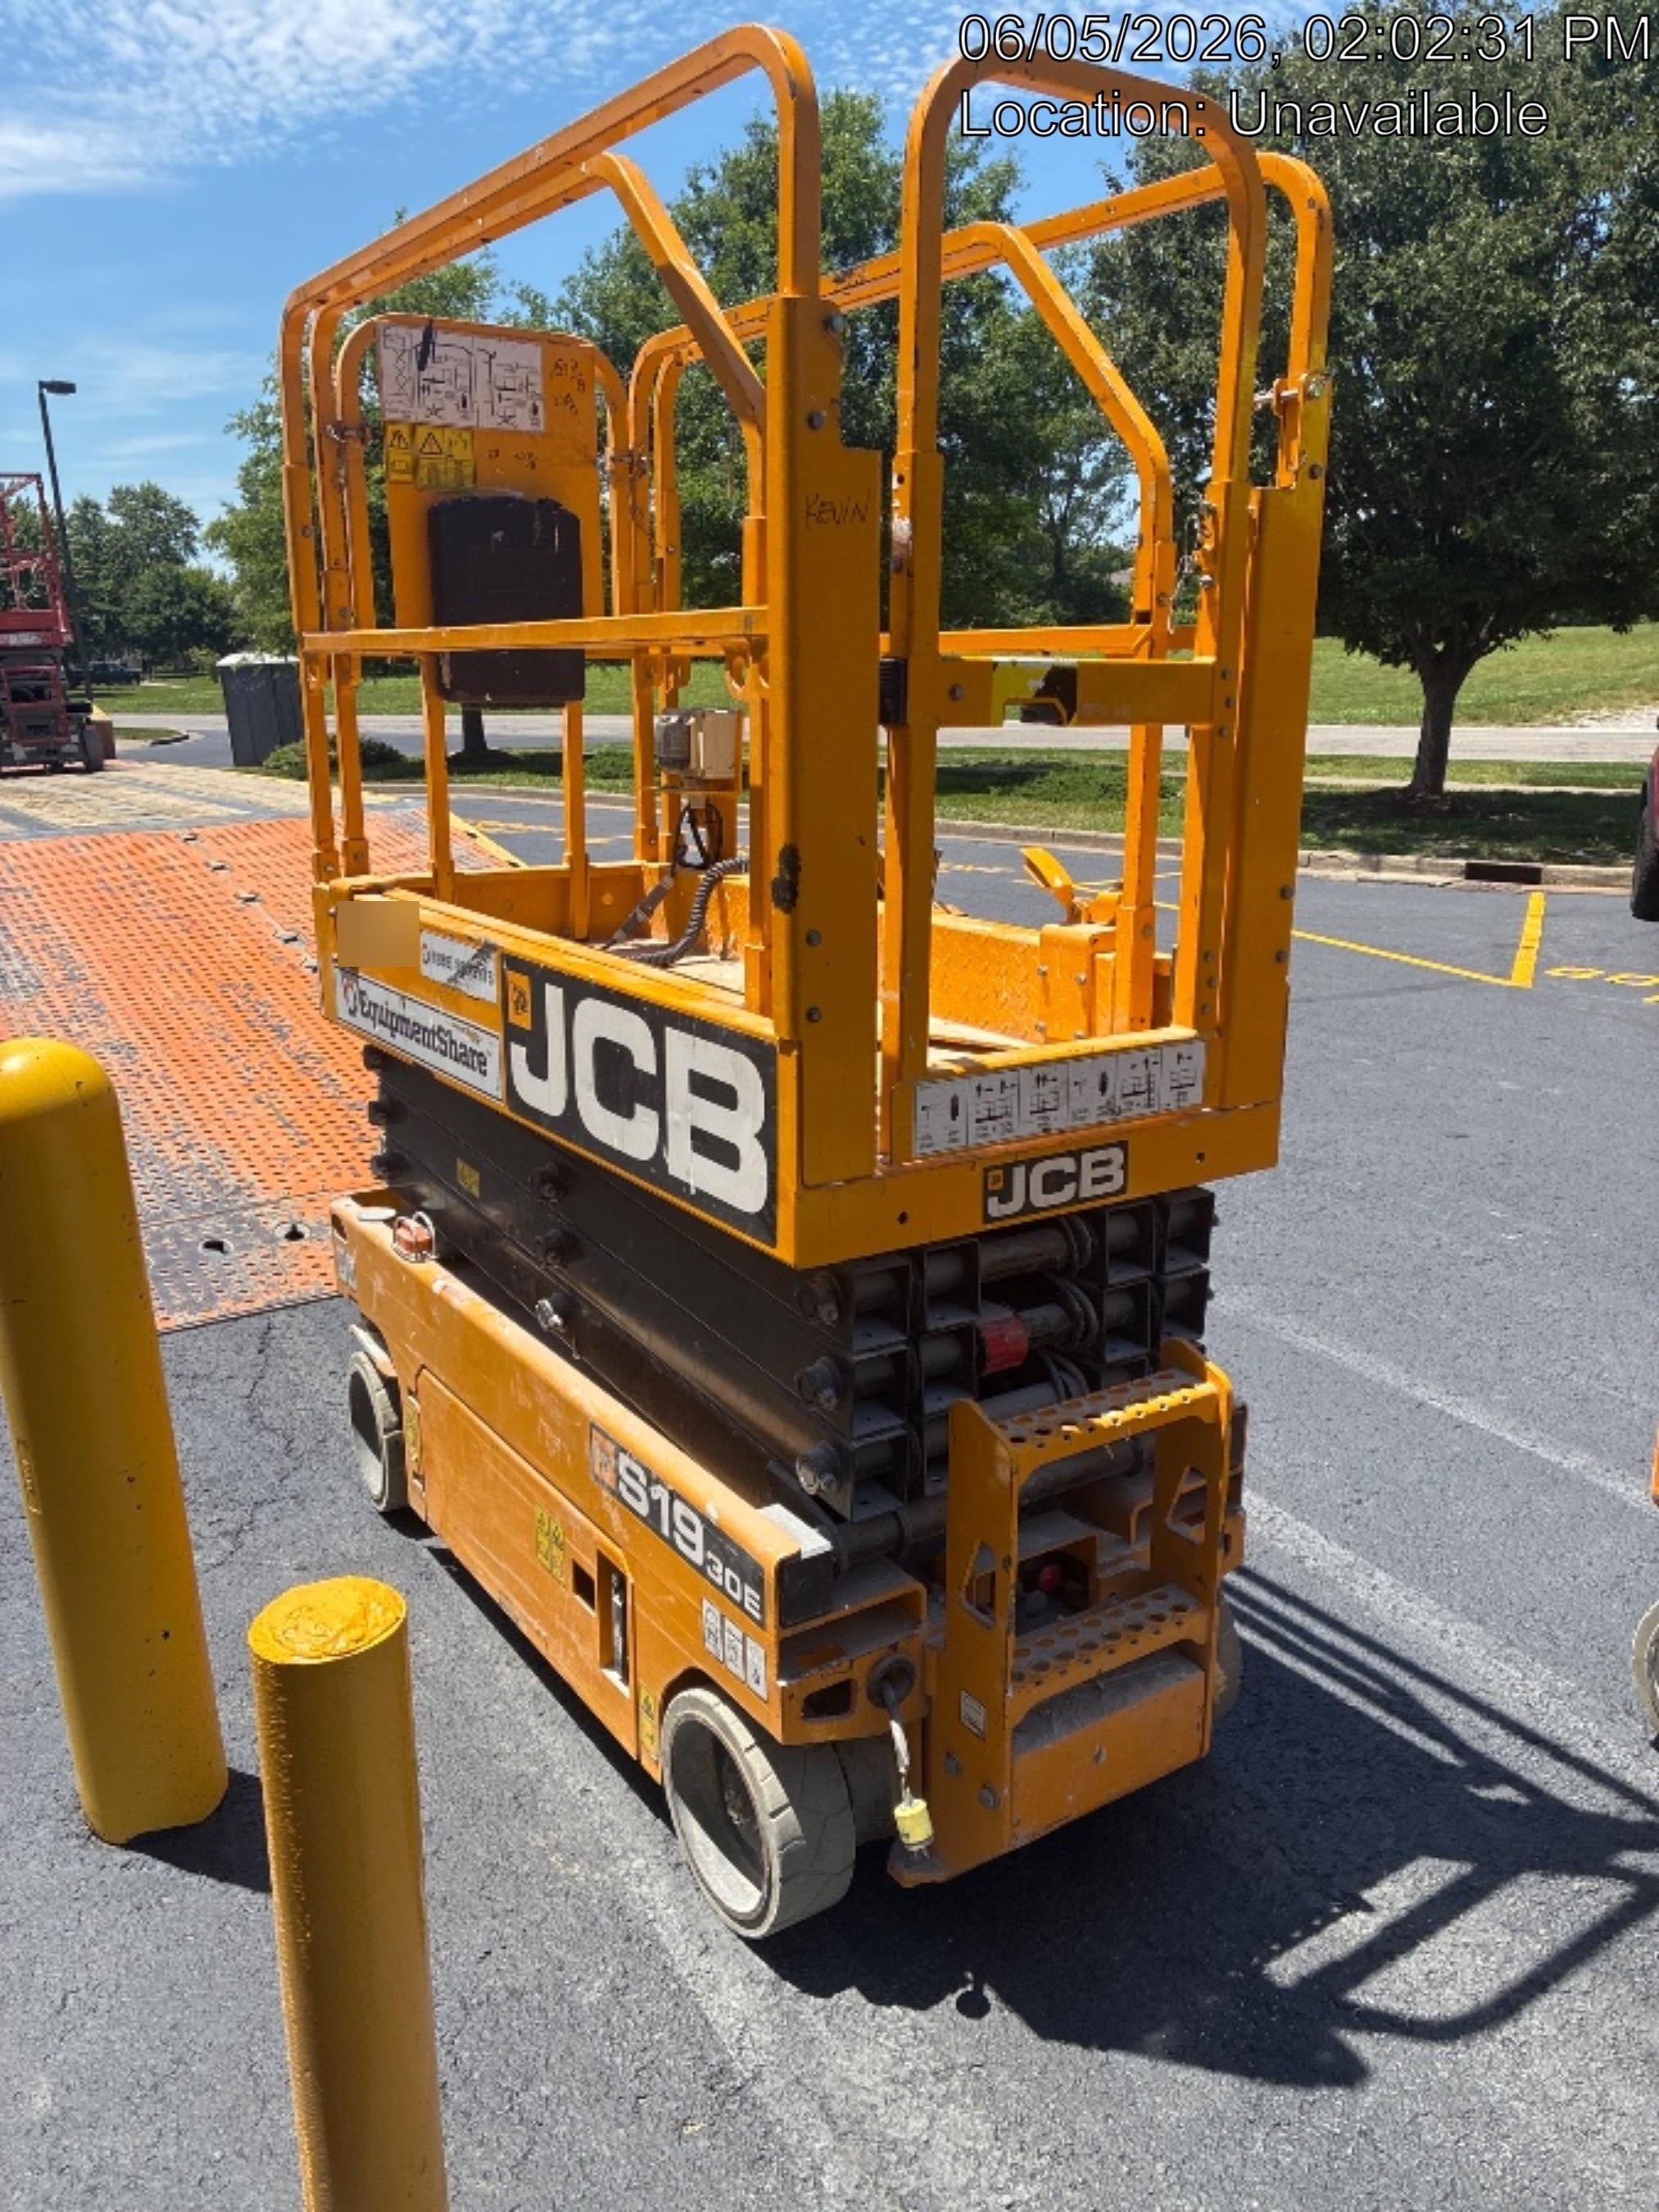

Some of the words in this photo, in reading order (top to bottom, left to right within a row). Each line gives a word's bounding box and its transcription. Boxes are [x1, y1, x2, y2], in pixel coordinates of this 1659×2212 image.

[358, 988, 488, 1077] EquipmentShare
[510, 982, 768, 1213] JCB
[986, 1146, 1125, 1218] JCB
